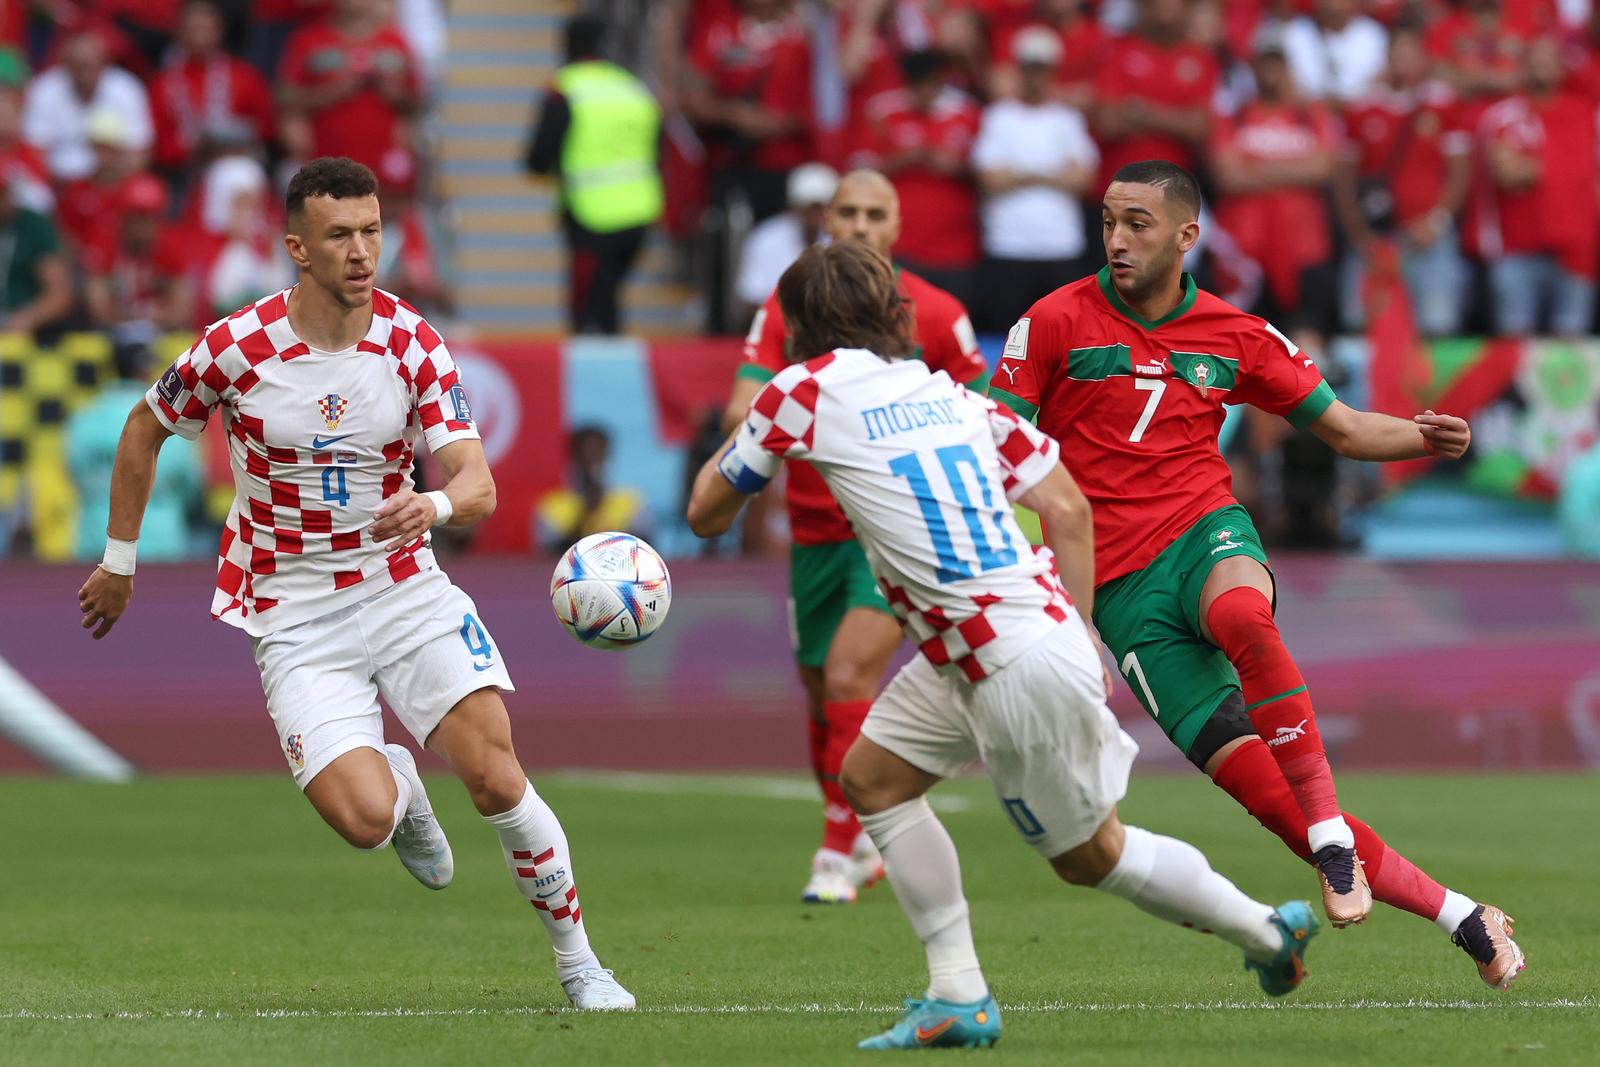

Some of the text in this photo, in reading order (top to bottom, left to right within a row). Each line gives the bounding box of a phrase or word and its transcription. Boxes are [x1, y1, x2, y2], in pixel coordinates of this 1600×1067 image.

[1135, 364, 1163, 375] PUMA
[1128, 377, 1167, 443] 7
[321, 466, 350, 506] 4
[888, 444, 1018, 584] 10
[460, 612, 491, 659] 4
[1121, 651, 1160, 718] 7
[1002, 798, 1045, 836] 0
